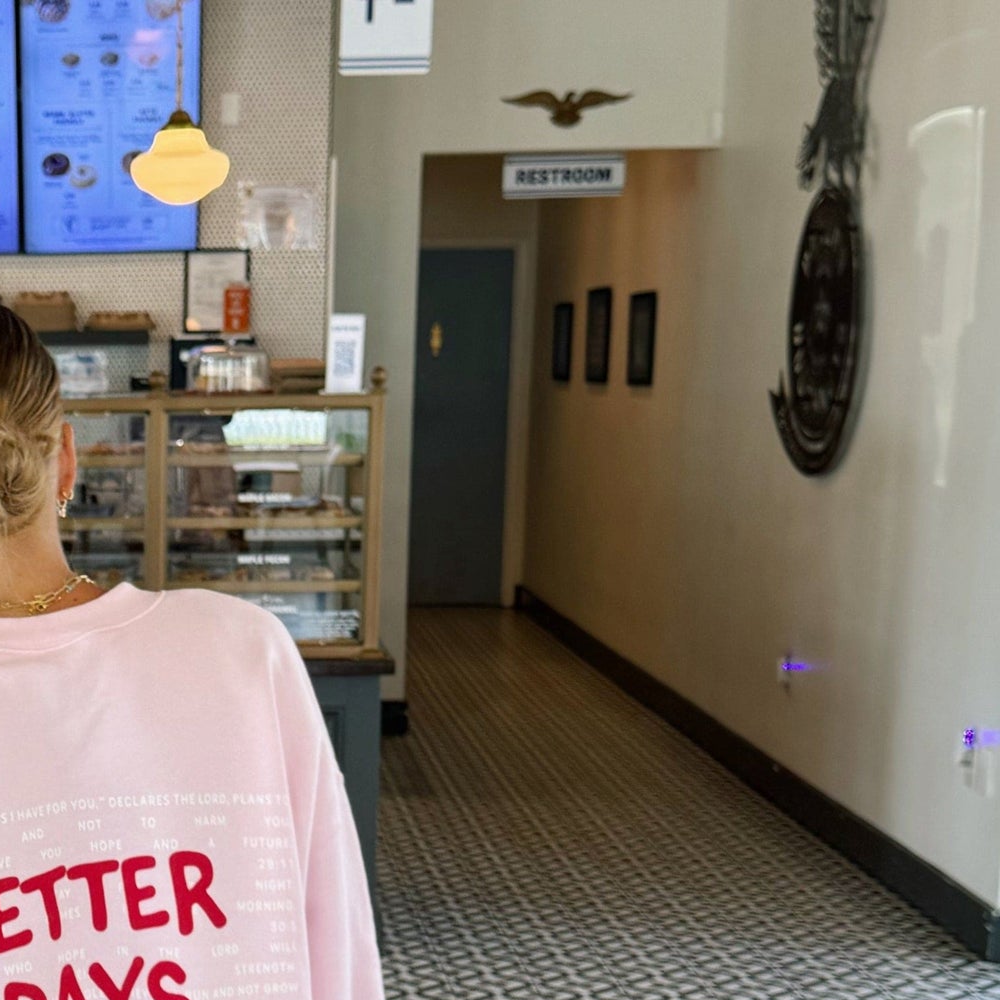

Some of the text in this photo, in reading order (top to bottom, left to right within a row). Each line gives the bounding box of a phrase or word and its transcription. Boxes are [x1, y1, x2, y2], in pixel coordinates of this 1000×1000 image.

[515, 167, 613, 185] RESTROOM
[16, 804, 44, 821] HAVE
[46, 801, 68, 816] FOR
[108, 794, 170, 809] DECLARES
[173, 793, 195, 807] THE
[232, 792, 272, 806] PLANS
[21, 827, 44, 844] AND
[77, 818, 102, 832] NOT
[141, 816, 156, 830] TO
[194, 814, 227, 827] HARM
[39, 846, 62, 861] YOU
[89, 839, 123, 852] HOPE
[153, 838, 180, 851] AND
[2, 960, 33, 977] WHO
[211, 942, 240, 958] LORD
